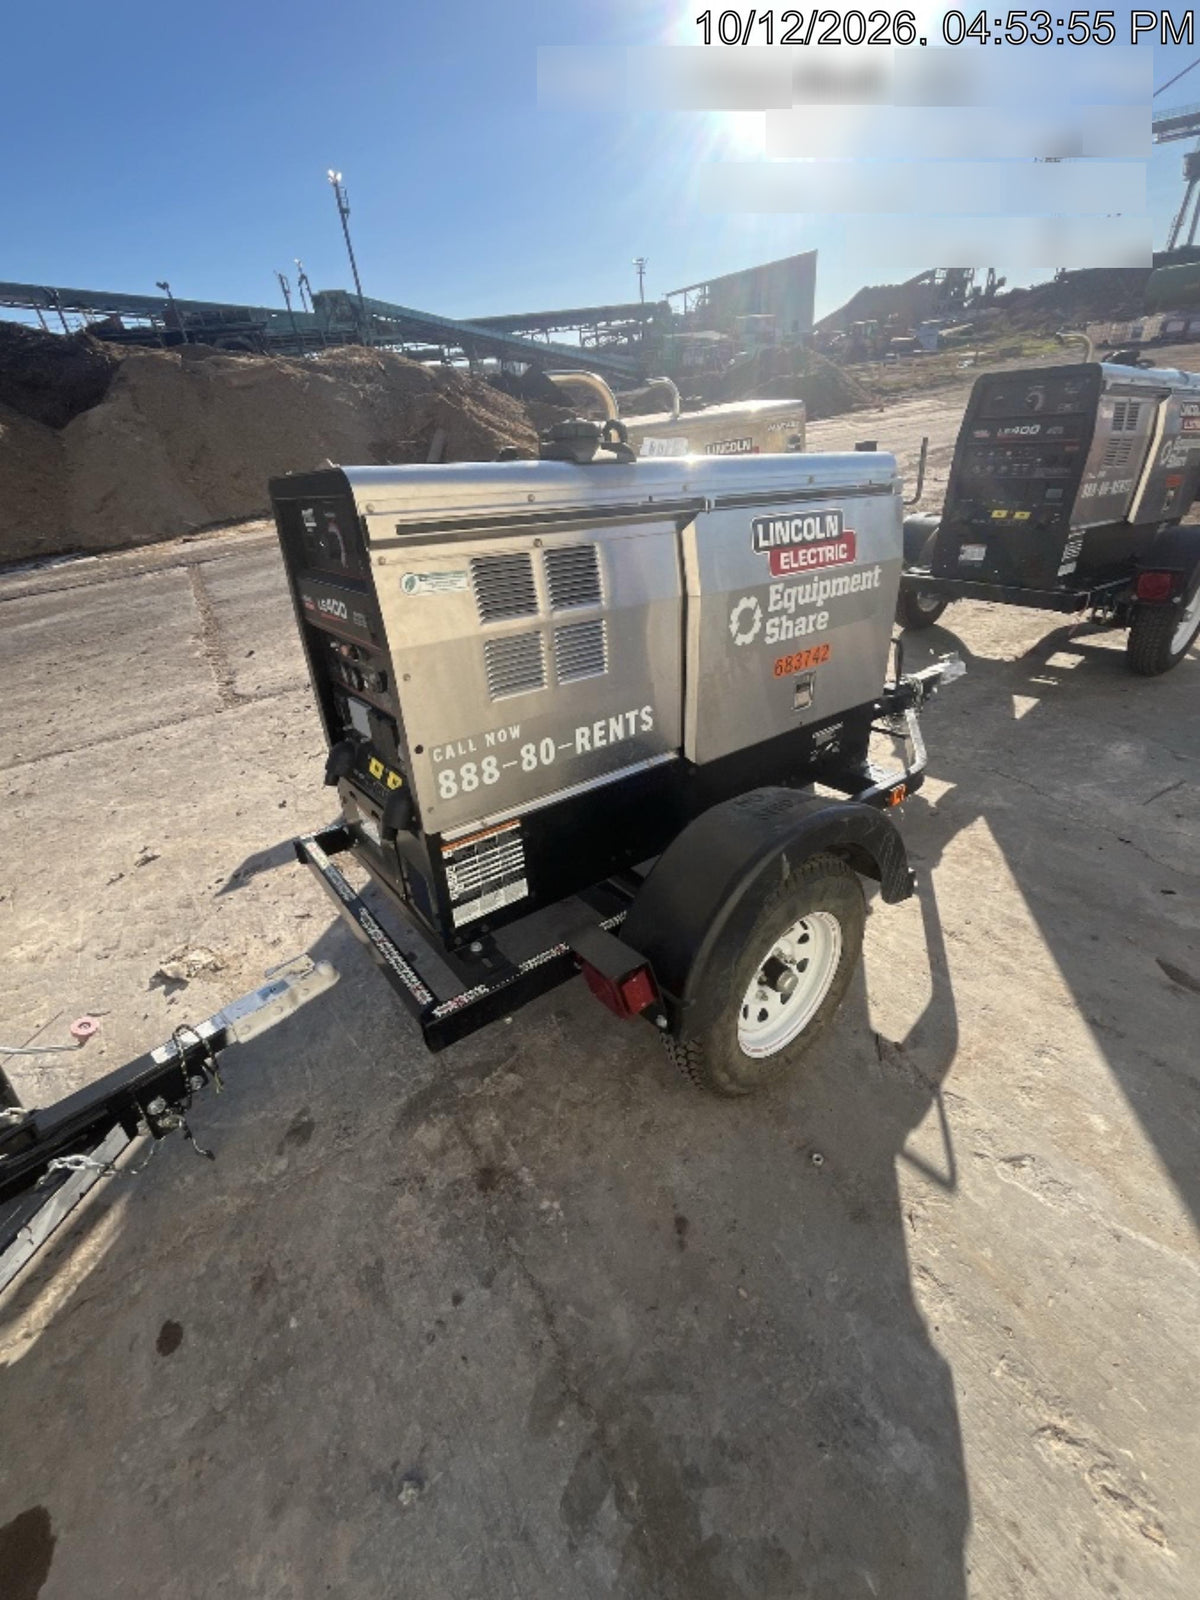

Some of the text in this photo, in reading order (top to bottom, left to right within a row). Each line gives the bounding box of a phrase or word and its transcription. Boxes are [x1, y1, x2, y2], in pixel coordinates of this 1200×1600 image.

[706, 437, 751, 455] LINCOLN
[756, 514, 839, 548] LINCOLN
[779, 543, 848, 570] ELECTRIC
[767, 564, 883, 613] Equipment
[764, 610, 830, 645] Share
[774, 644, 831, 677] 683742
[432, 724, 522, 763] CALL NOW
[437, 704, 655, 800] 888-80-RENTS
